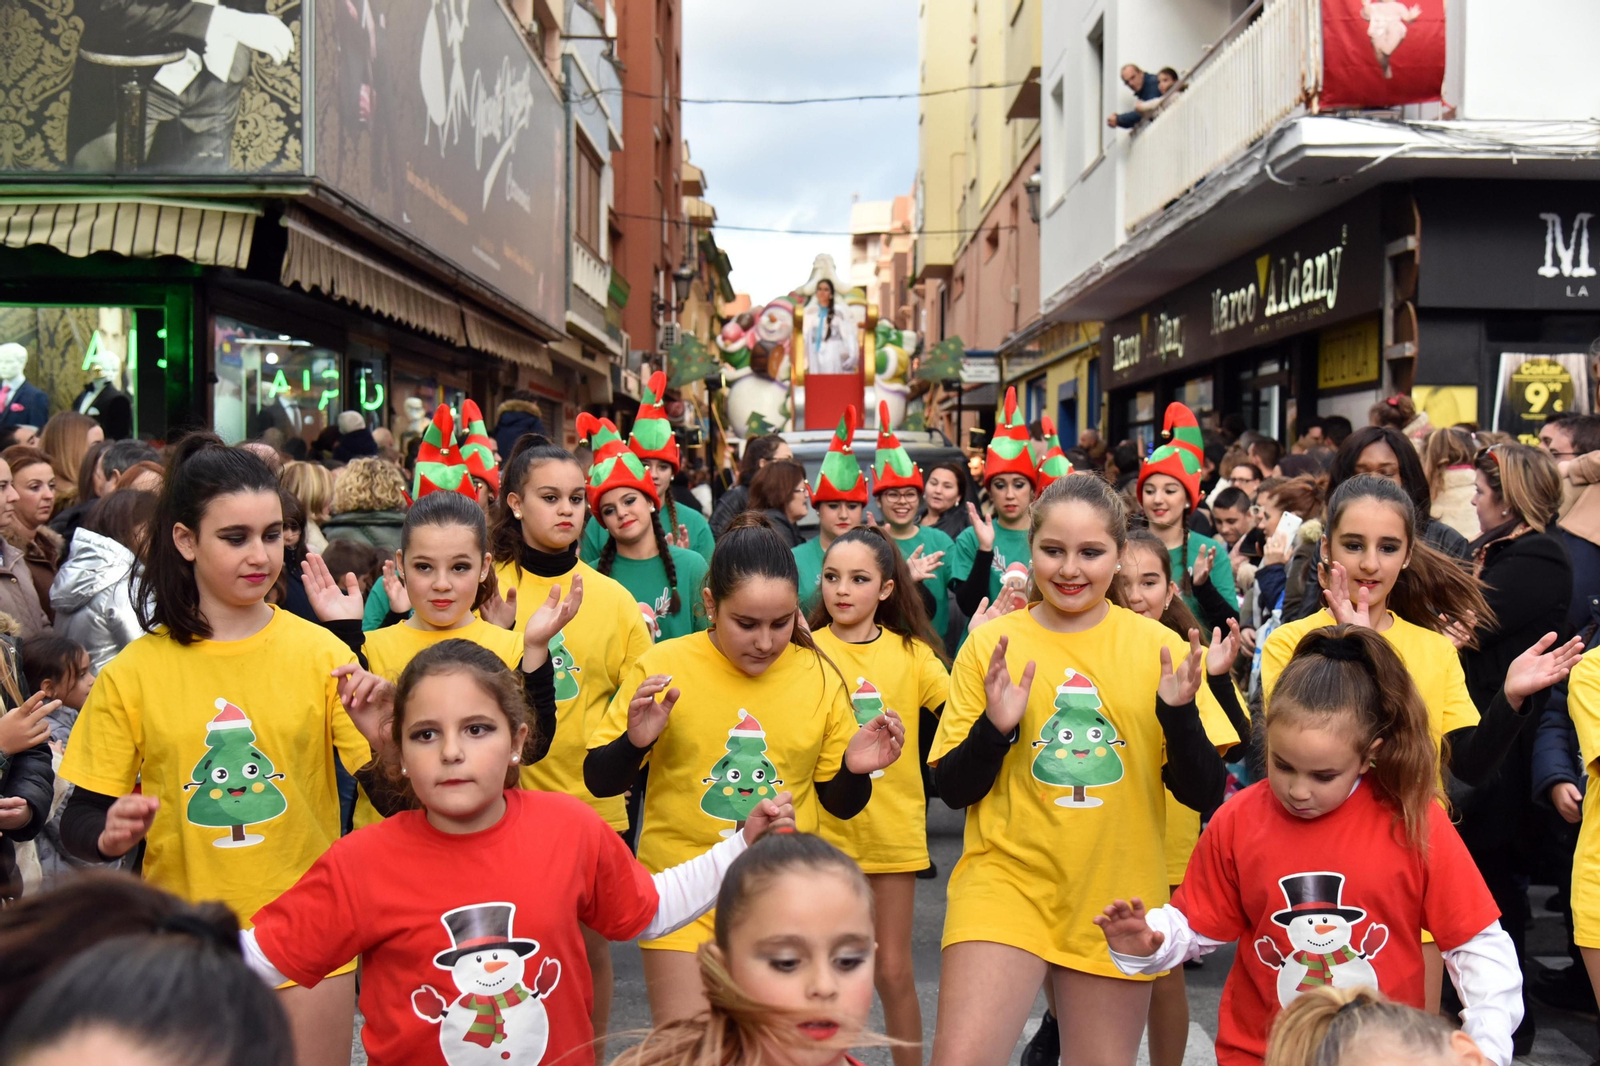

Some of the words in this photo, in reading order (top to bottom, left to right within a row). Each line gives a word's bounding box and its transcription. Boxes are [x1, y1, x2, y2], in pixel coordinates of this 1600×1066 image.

[1211, 288, 1257, 335] Marco
[1265, 246, 1343, 317] Aldany
[1566, 285, 1589, 297] LA
[1113, 334, 1140, 371] Marco
[1521, 362, 1563, 375] Cortar
